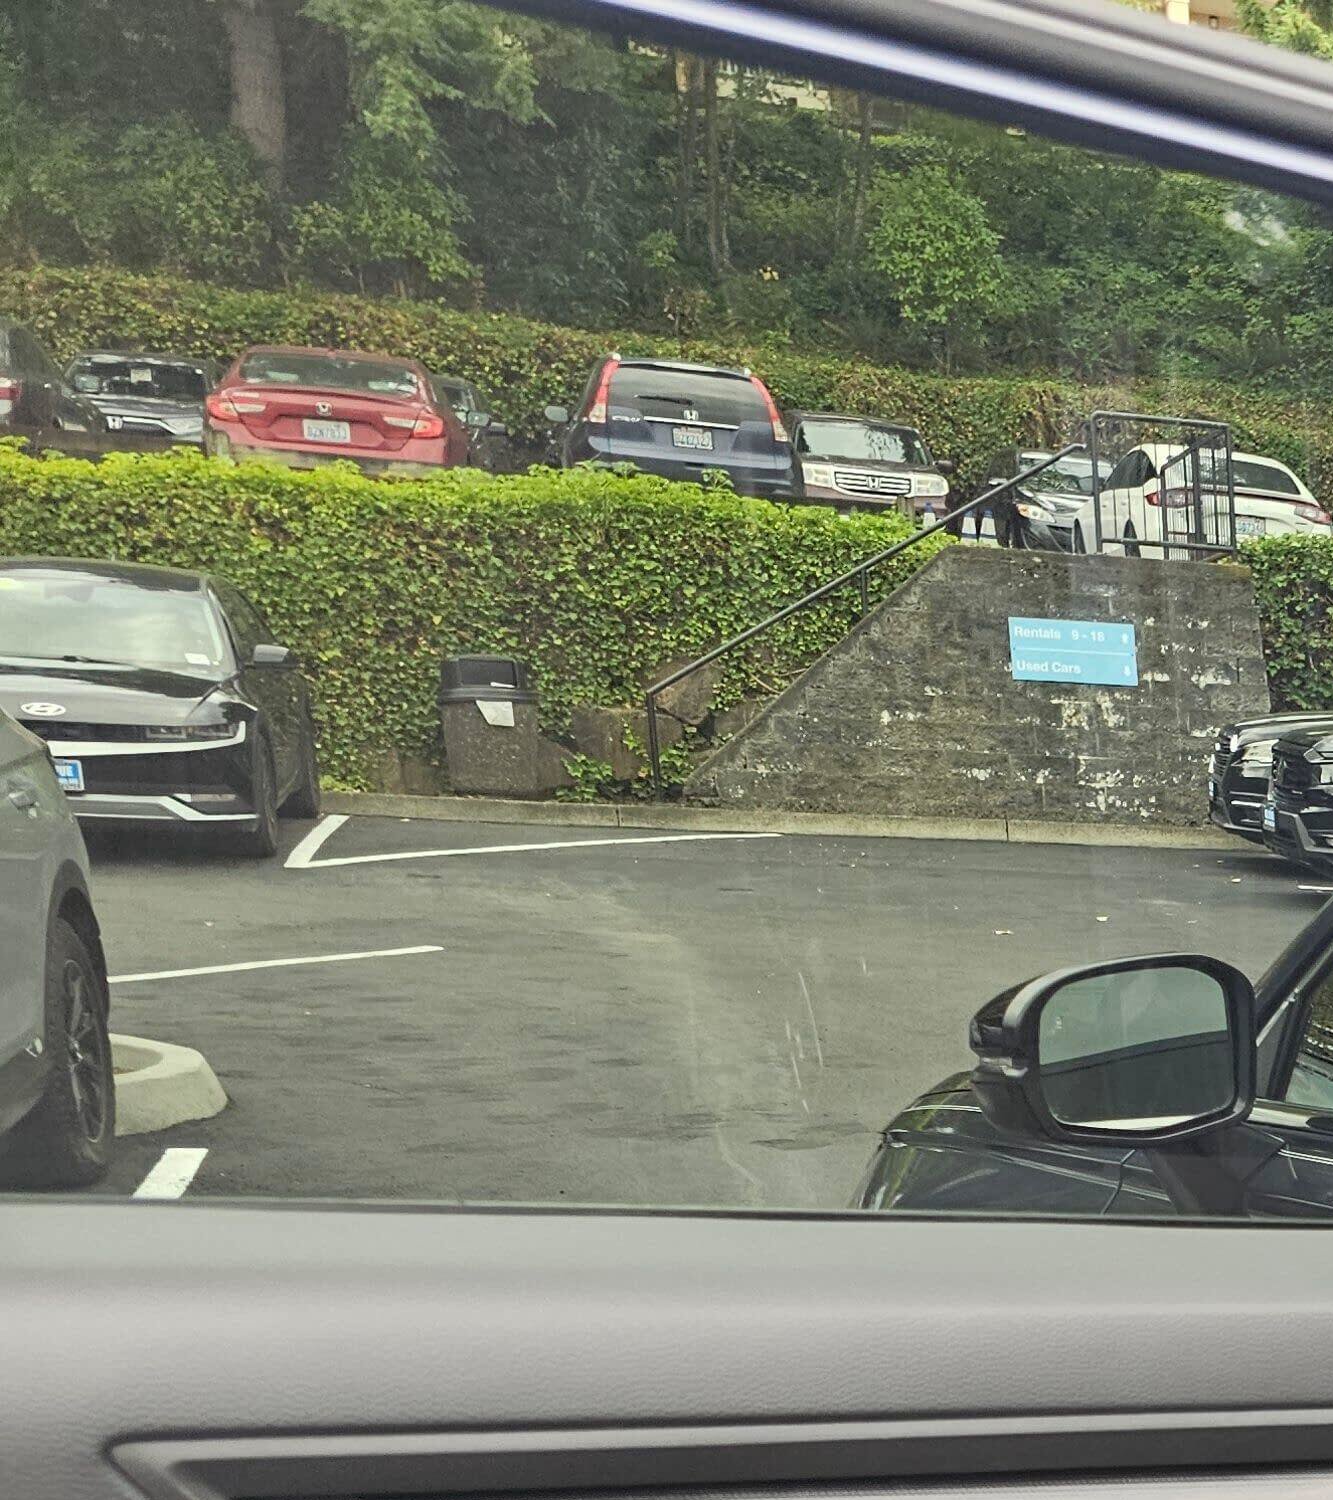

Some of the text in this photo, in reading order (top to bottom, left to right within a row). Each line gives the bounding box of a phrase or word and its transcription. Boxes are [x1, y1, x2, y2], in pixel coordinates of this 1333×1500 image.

[1014, 625, 1061, 640] Rentals
[1071, 629, 1079, 641] 9
[1016, 659, 1081, 674] Used Cars
